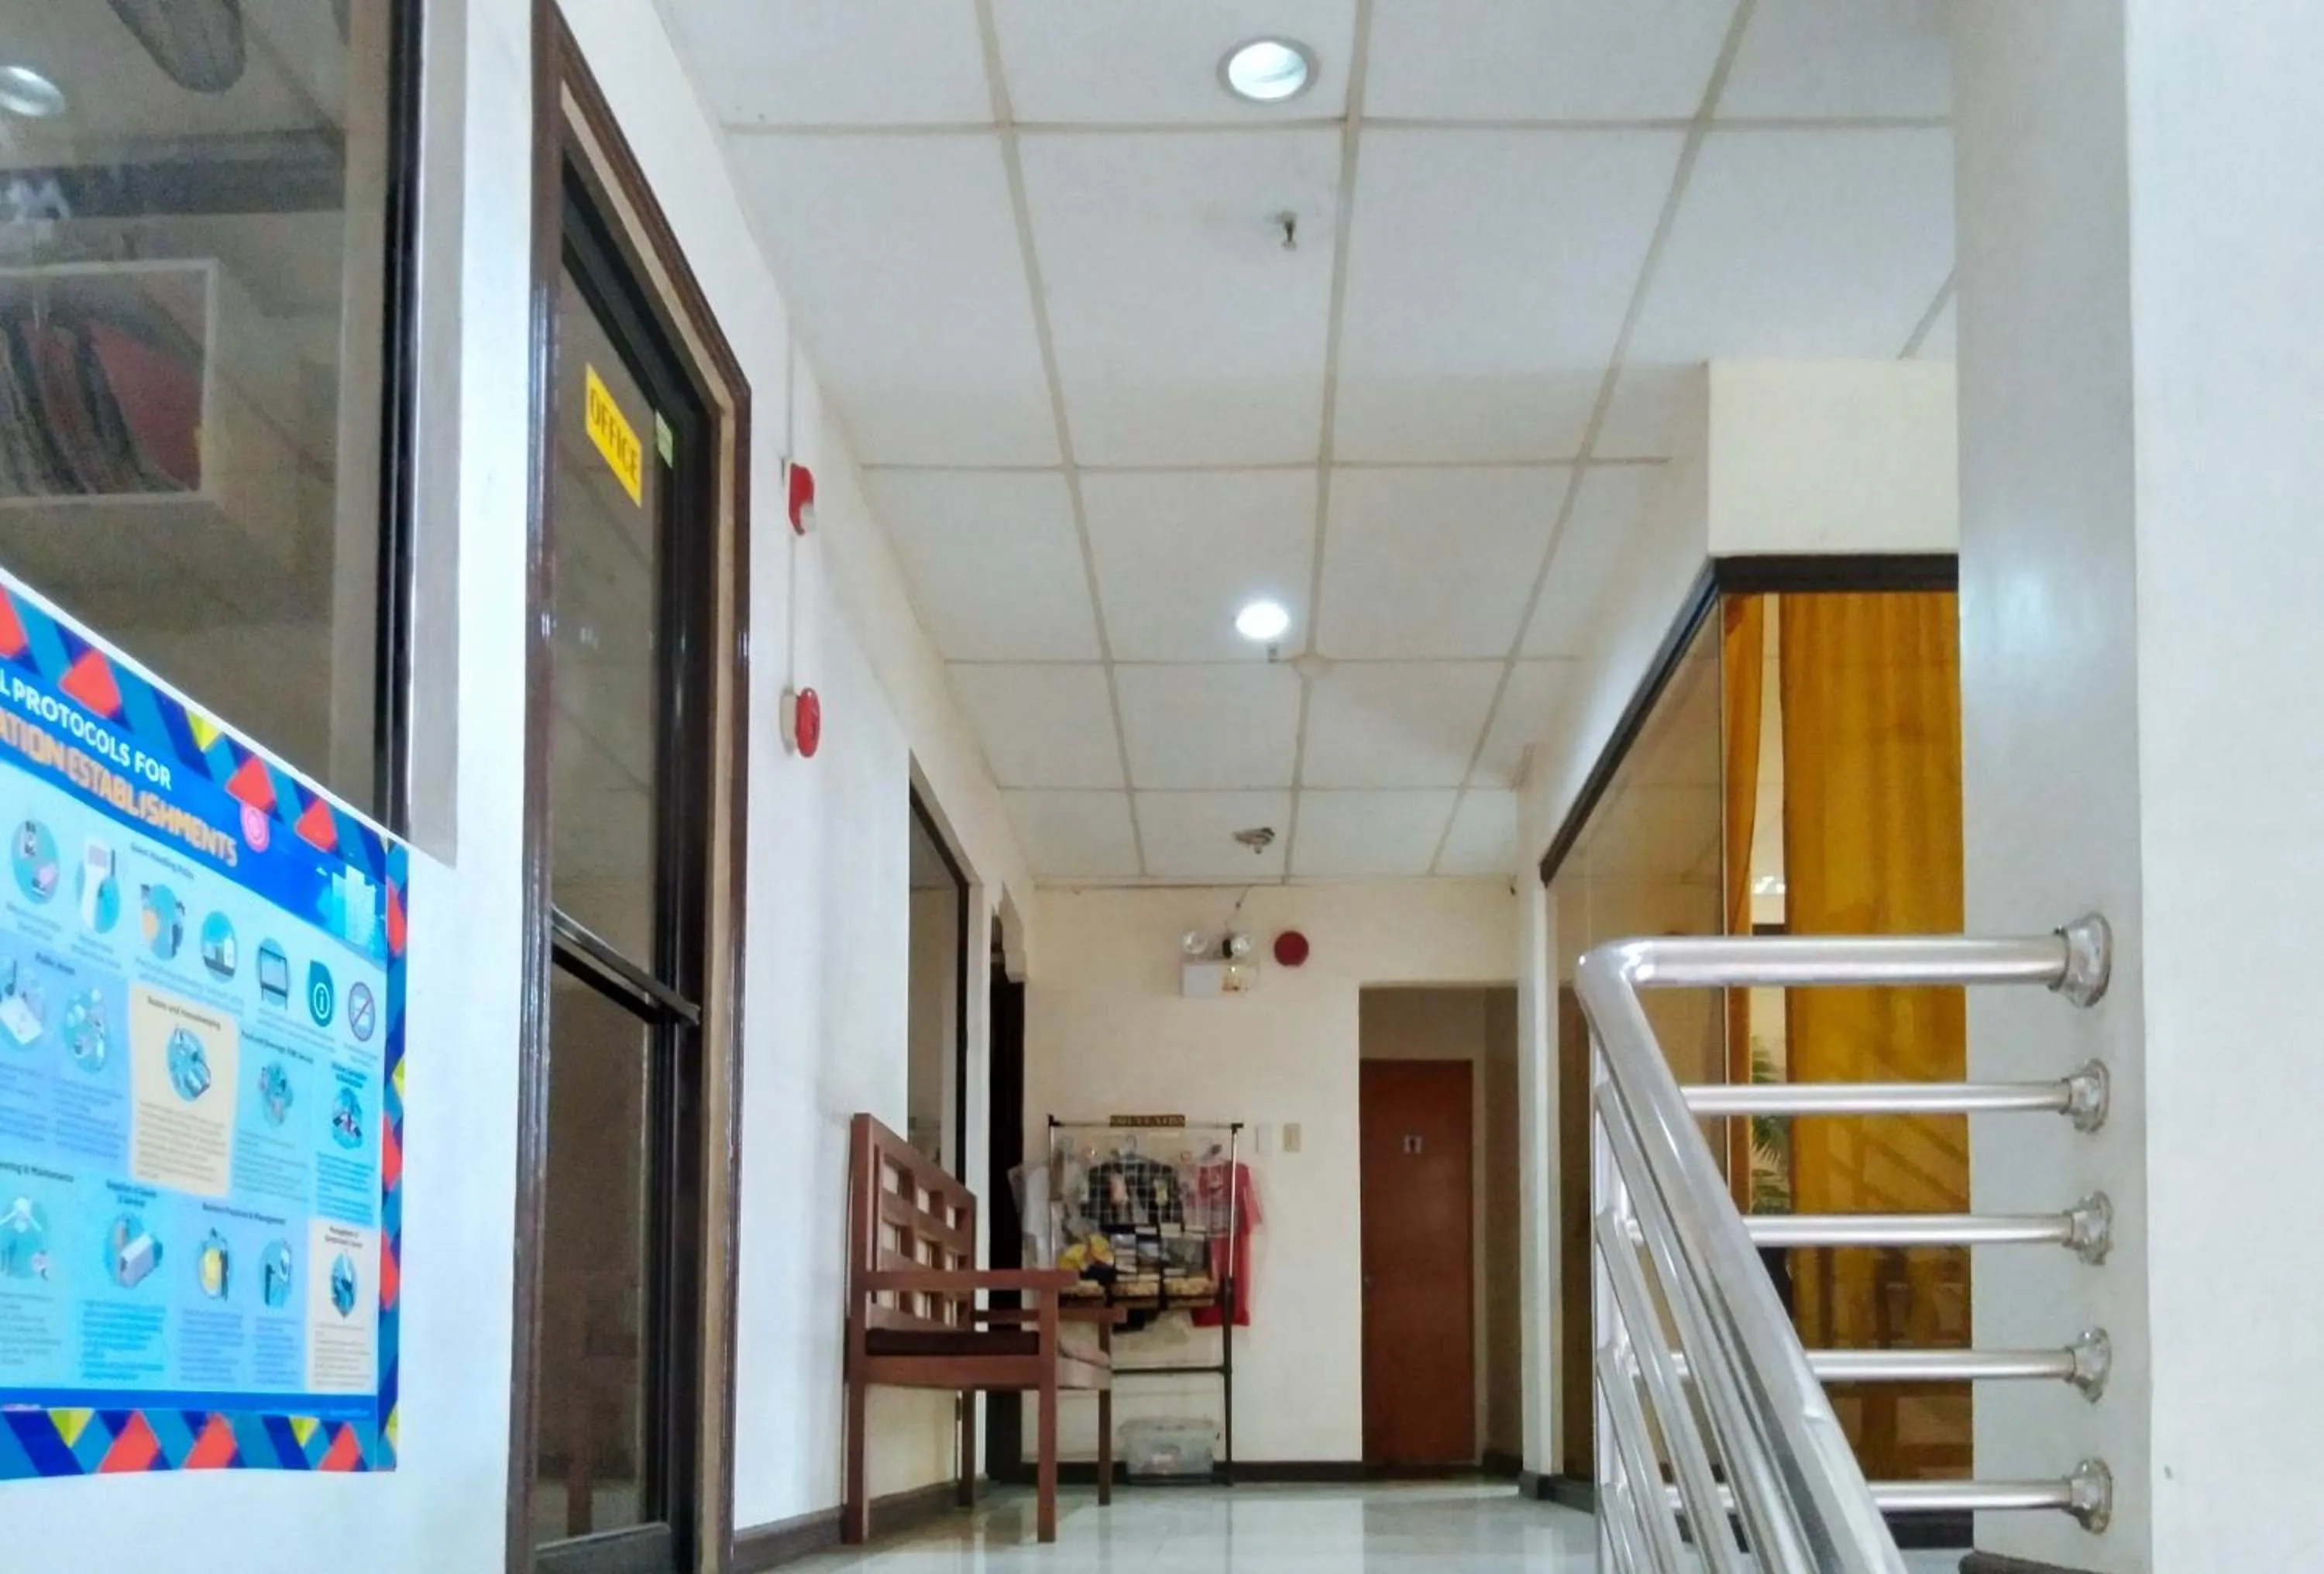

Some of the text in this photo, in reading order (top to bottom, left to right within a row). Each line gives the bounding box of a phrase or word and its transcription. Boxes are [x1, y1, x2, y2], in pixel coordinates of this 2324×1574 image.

[590, 387, 638, 486] OFFICE
[12, 677, 130, 767] PROTOCOLS
[135, 751, 172, 790] FOR
[67, 747, 237, 867] ESTABLISHMENTS
